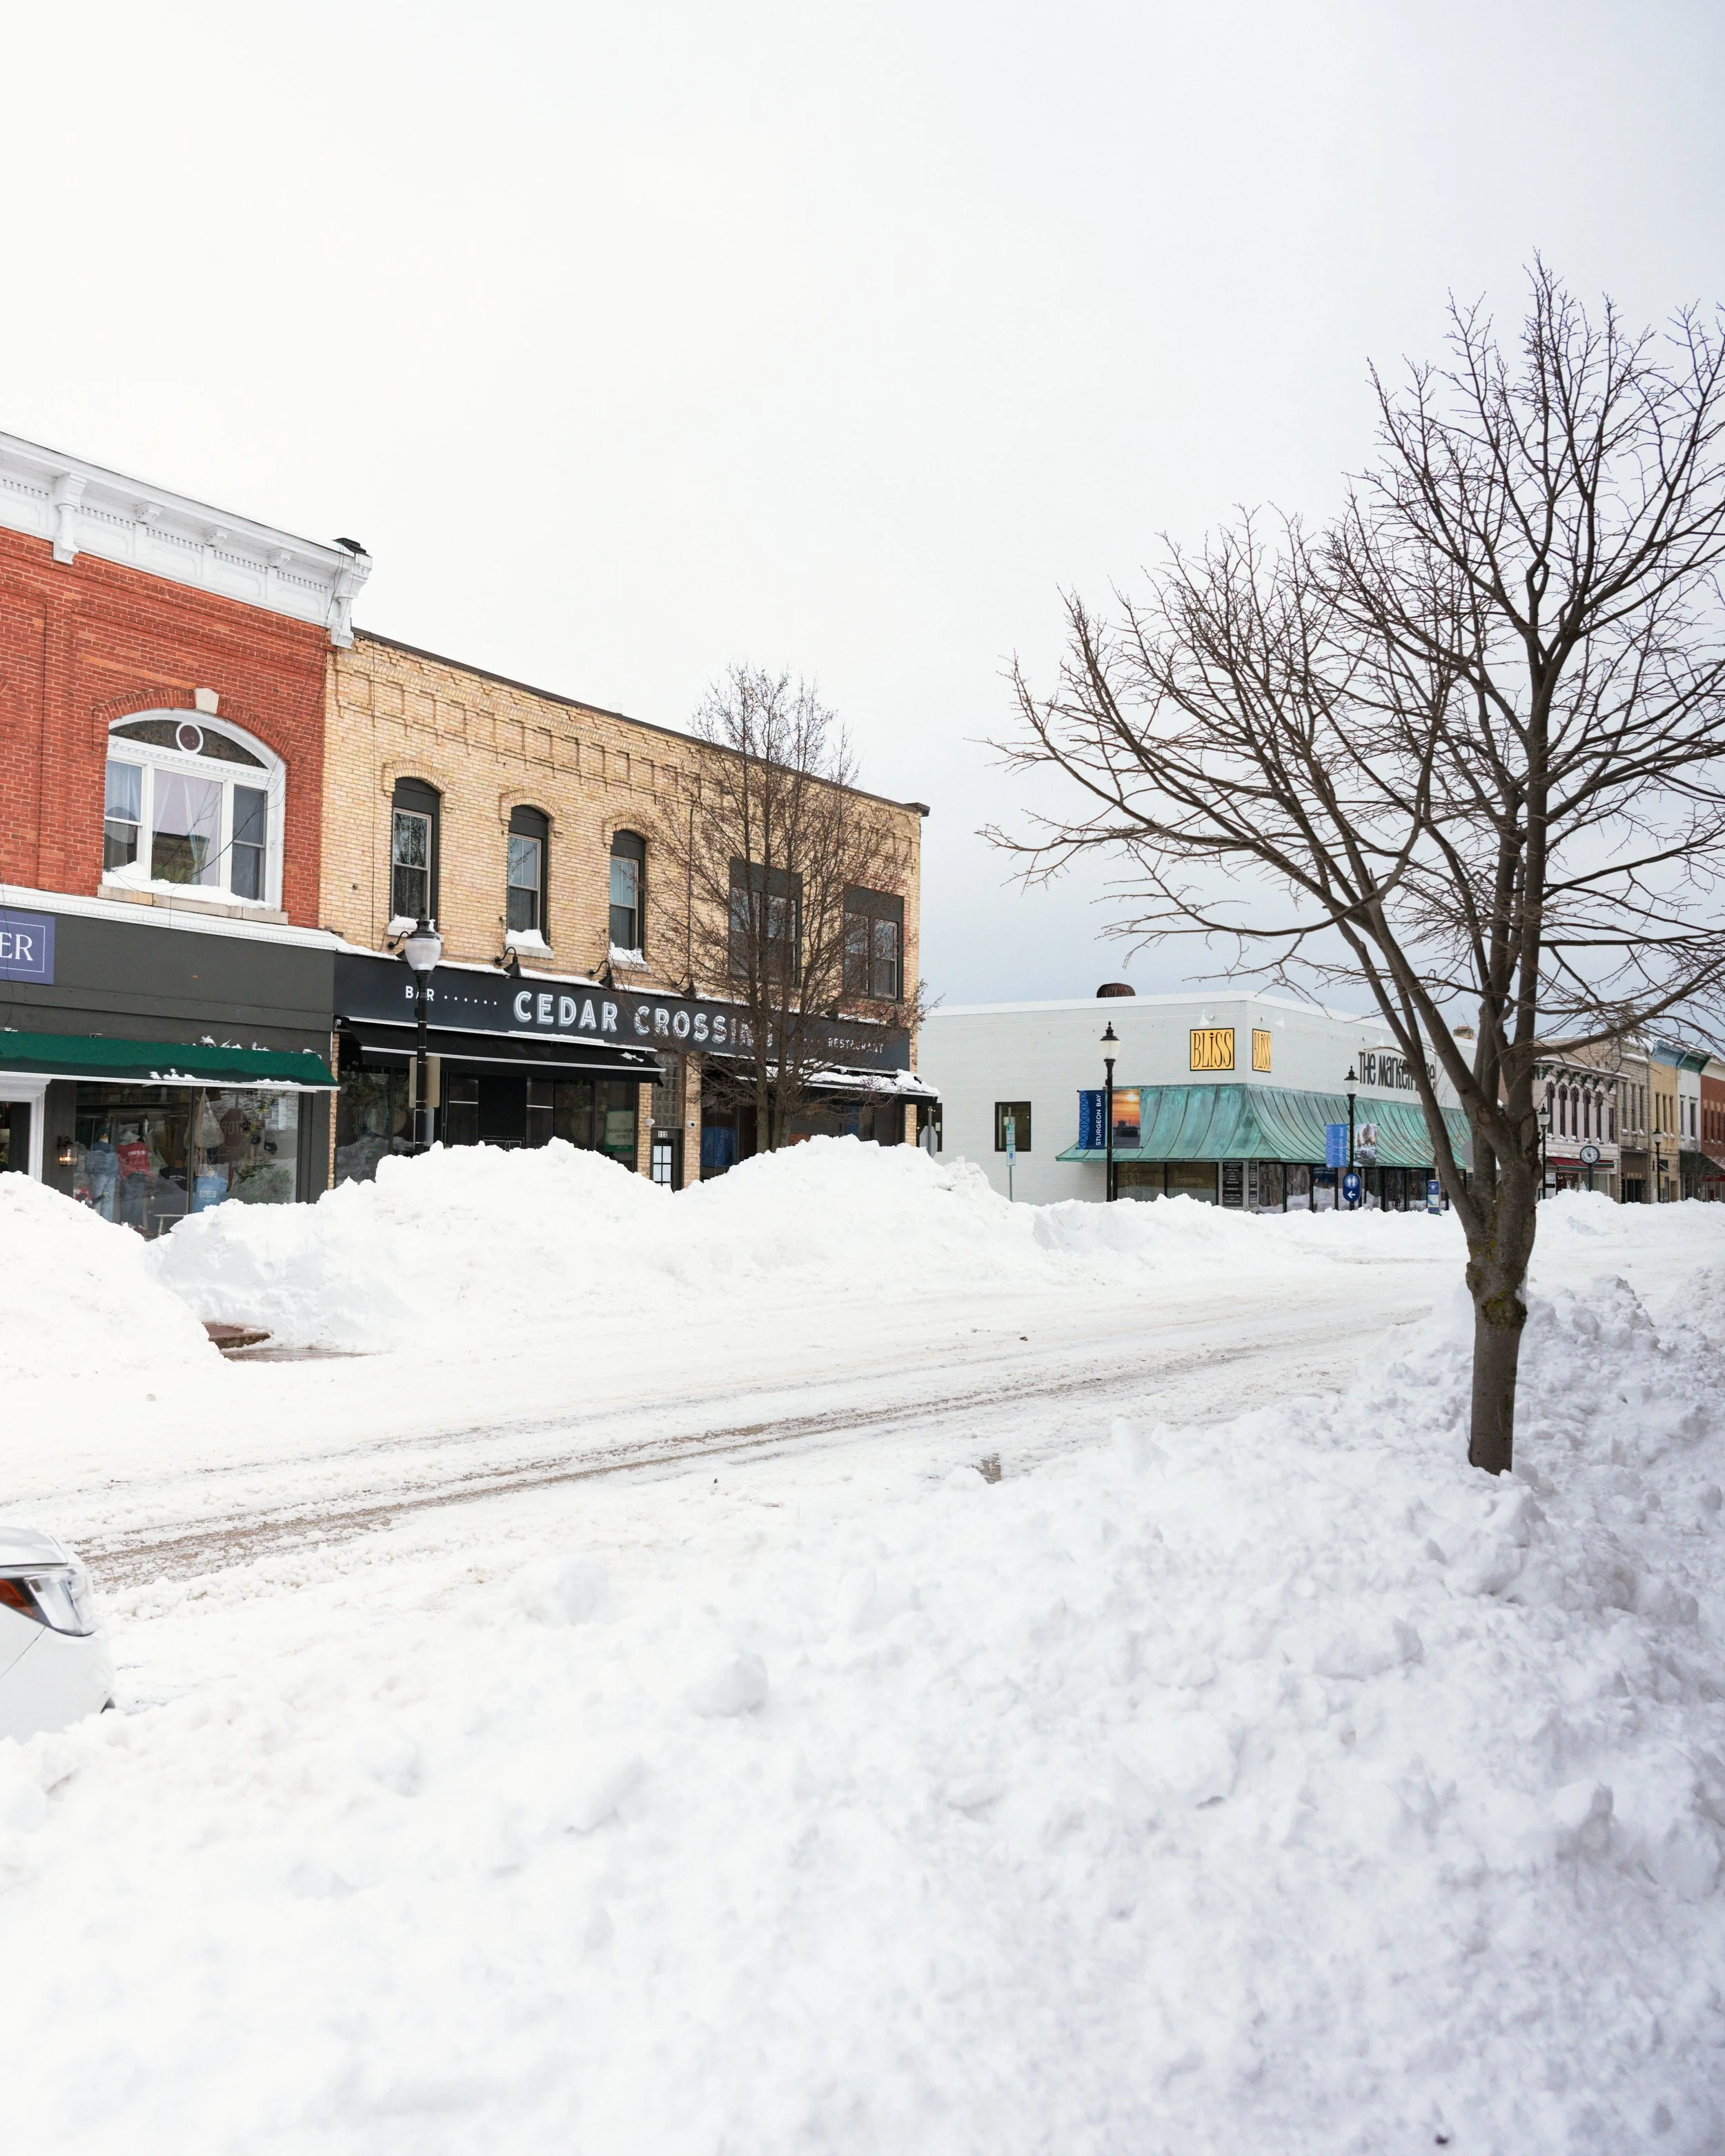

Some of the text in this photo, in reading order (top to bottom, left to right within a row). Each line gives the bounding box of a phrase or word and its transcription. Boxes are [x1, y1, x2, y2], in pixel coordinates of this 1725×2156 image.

[405, 985, 435, 1001] BR
[513, 991, 773, 1048] CEDAR CROSSIN
